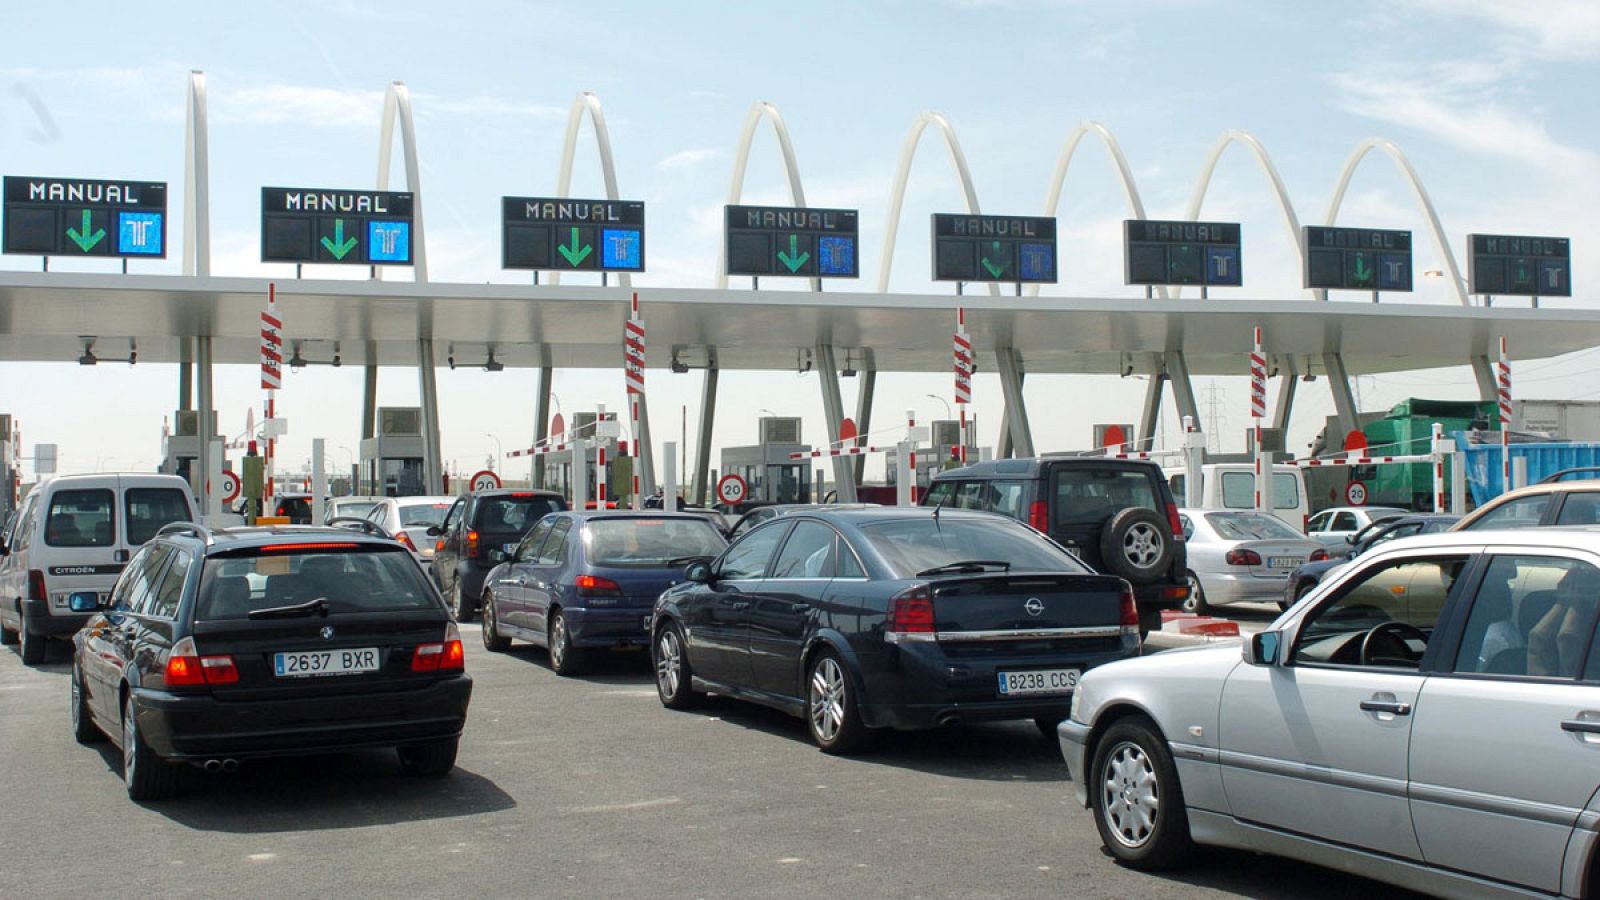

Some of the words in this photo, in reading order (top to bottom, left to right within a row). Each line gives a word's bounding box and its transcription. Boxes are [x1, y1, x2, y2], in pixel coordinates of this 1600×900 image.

[30, 182, 138, 203] MANUAL
[285, 192, 388, 213] MANUAL
[525, 202, 620, 221] MANUAL
[747, 211, 836, 229] MANUAL
[953, 218, 1036, 236] MANUAL
[1323, 230, 1394, 248] MAAL
[223, 480, 233, 492] 0
[477, 480, 494, 490] 20
[724, 484, 741, 496] 20
[1351, 489, 1364, 499] 20
[288, 653, 331, 672] 2637
[342, 651, 374, 669] BXR
[1009, 674, 1045, 689] 8238
[1051, 671, 1077, 688] CCS
